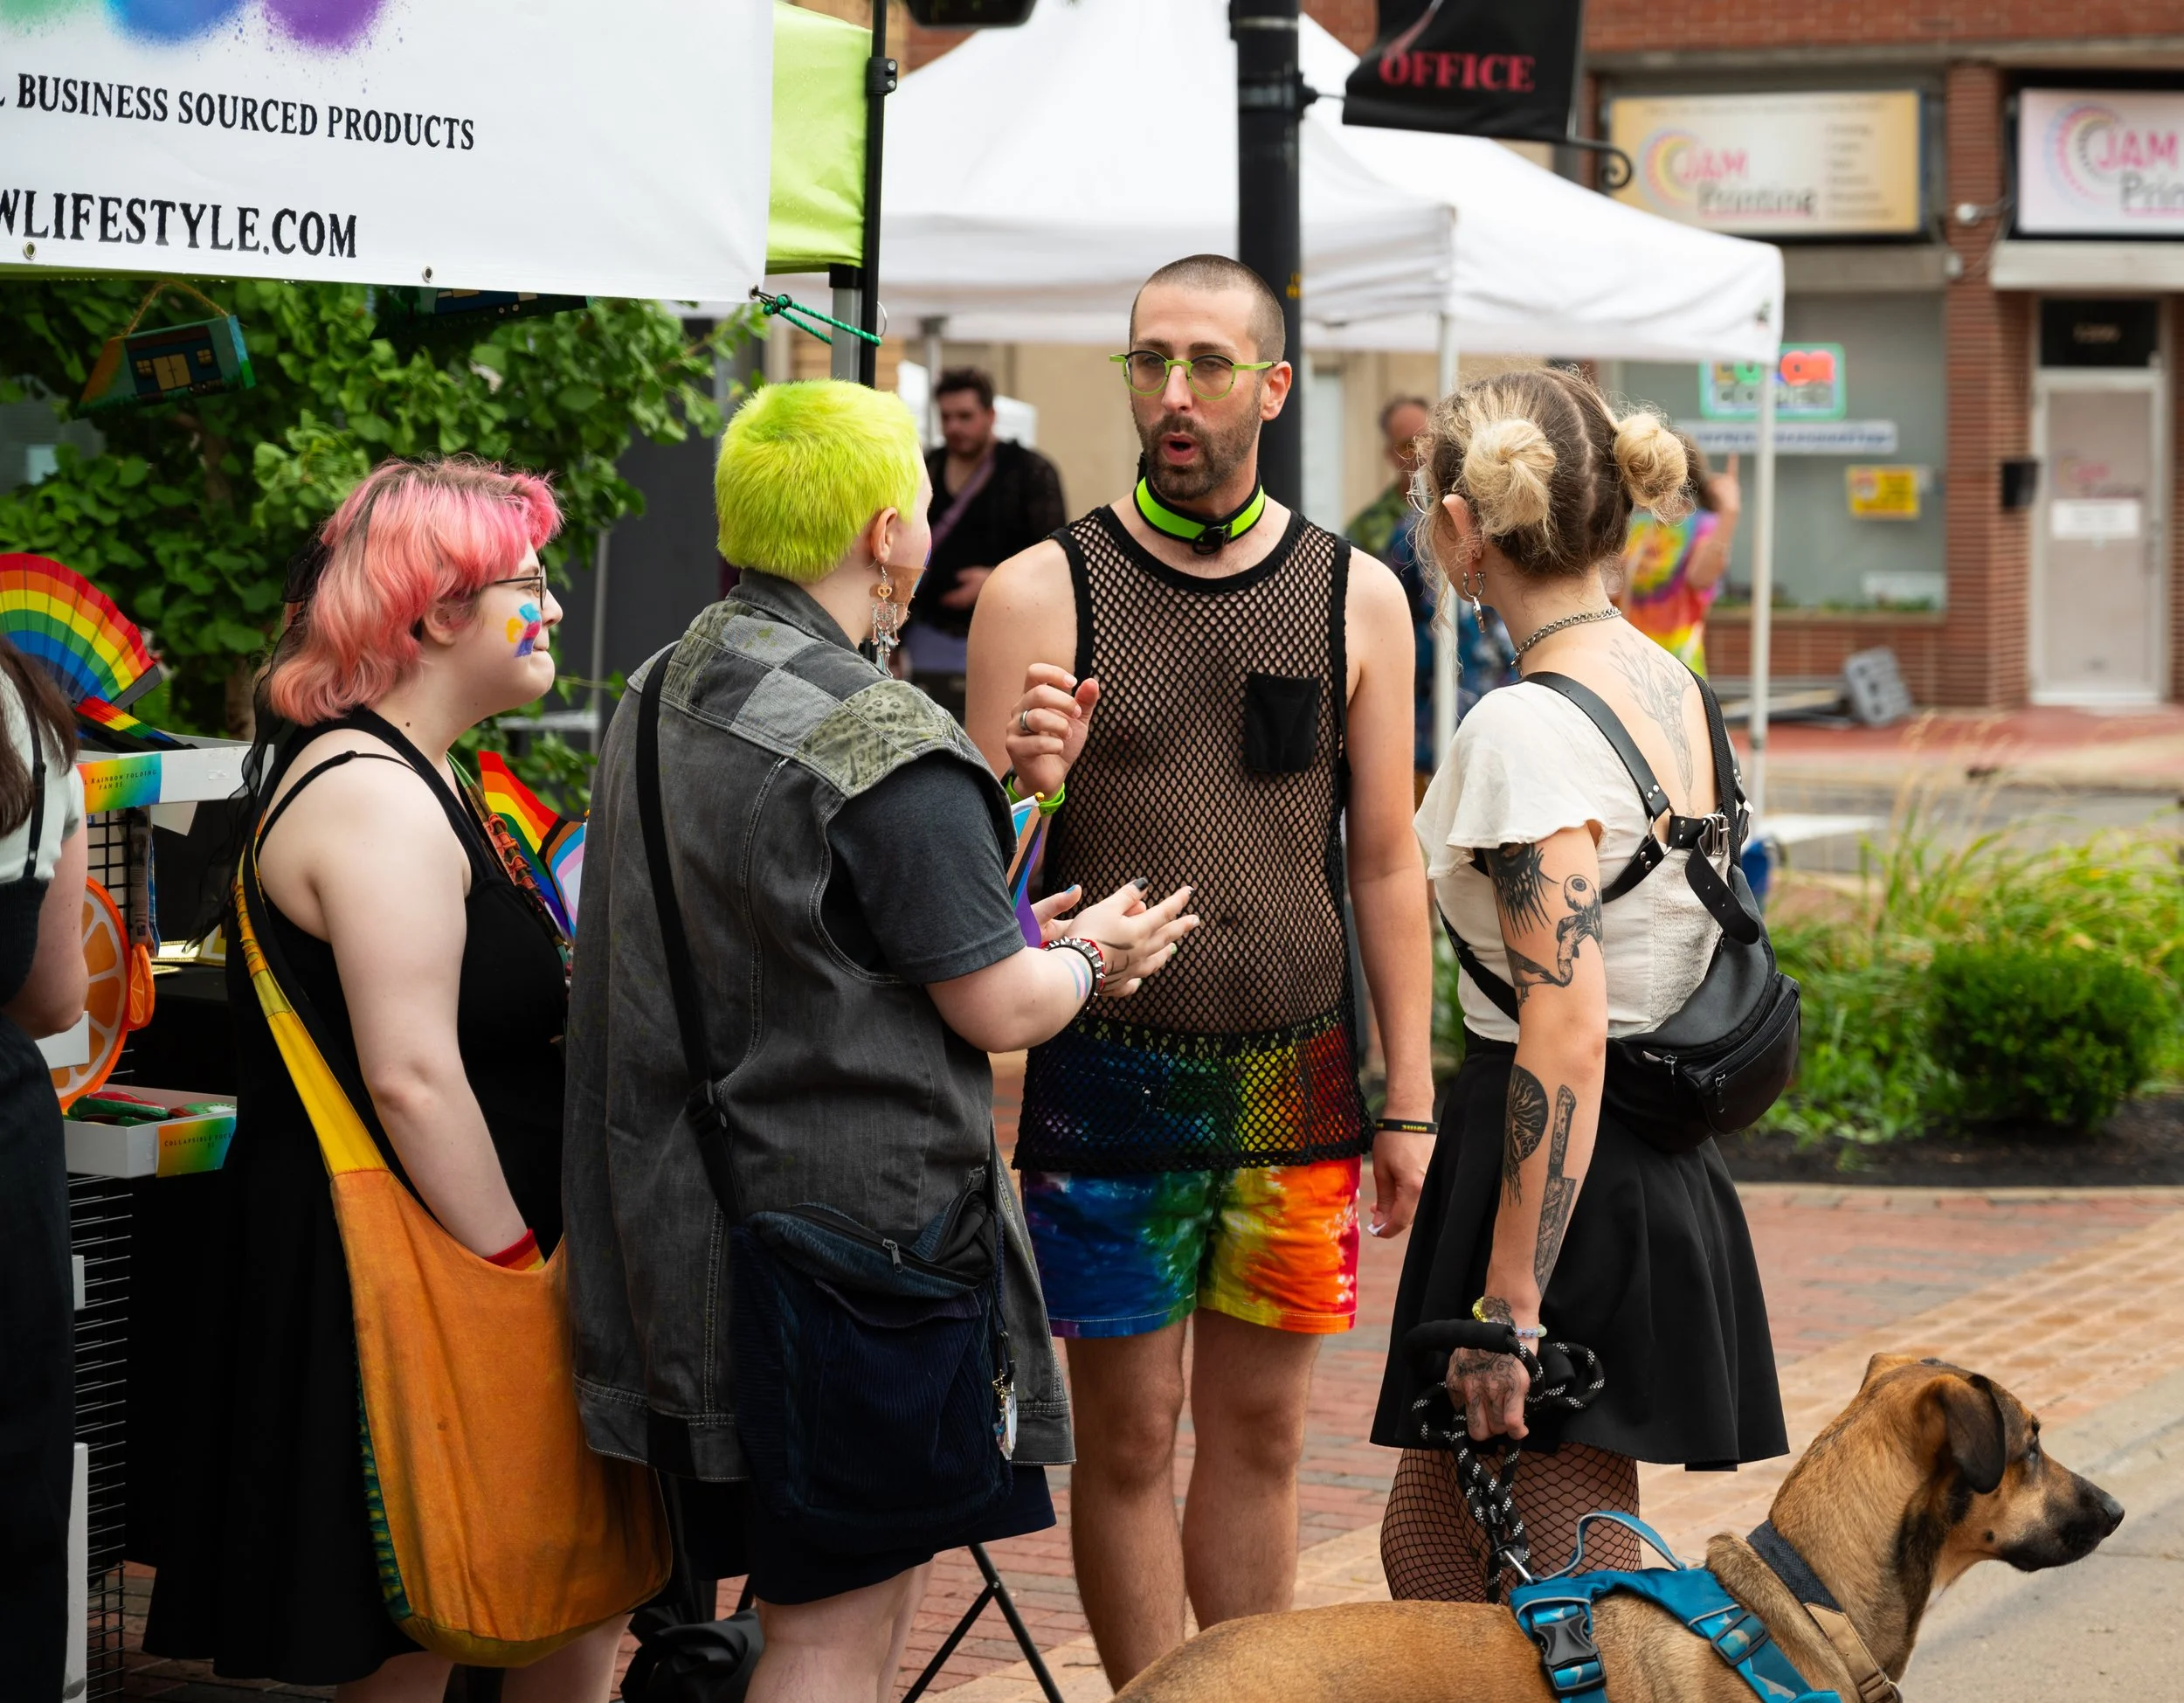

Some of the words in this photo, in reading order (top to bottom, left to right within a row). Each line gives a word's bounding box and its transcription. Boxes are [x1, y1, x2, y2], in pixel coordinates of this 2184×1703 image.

[1379, 51, 1536, 93] OFFICE
[17, 73, 169, 121] BUSINESS
[178, 90, 318, 136] SOURCED
[327, 106, 474, 150] PRODUCTS
[2098, 129, 2179, 171] JAM
[91, 774, 123, 784] RAINBOW
[126, 769, 157, 779] FOLDING
